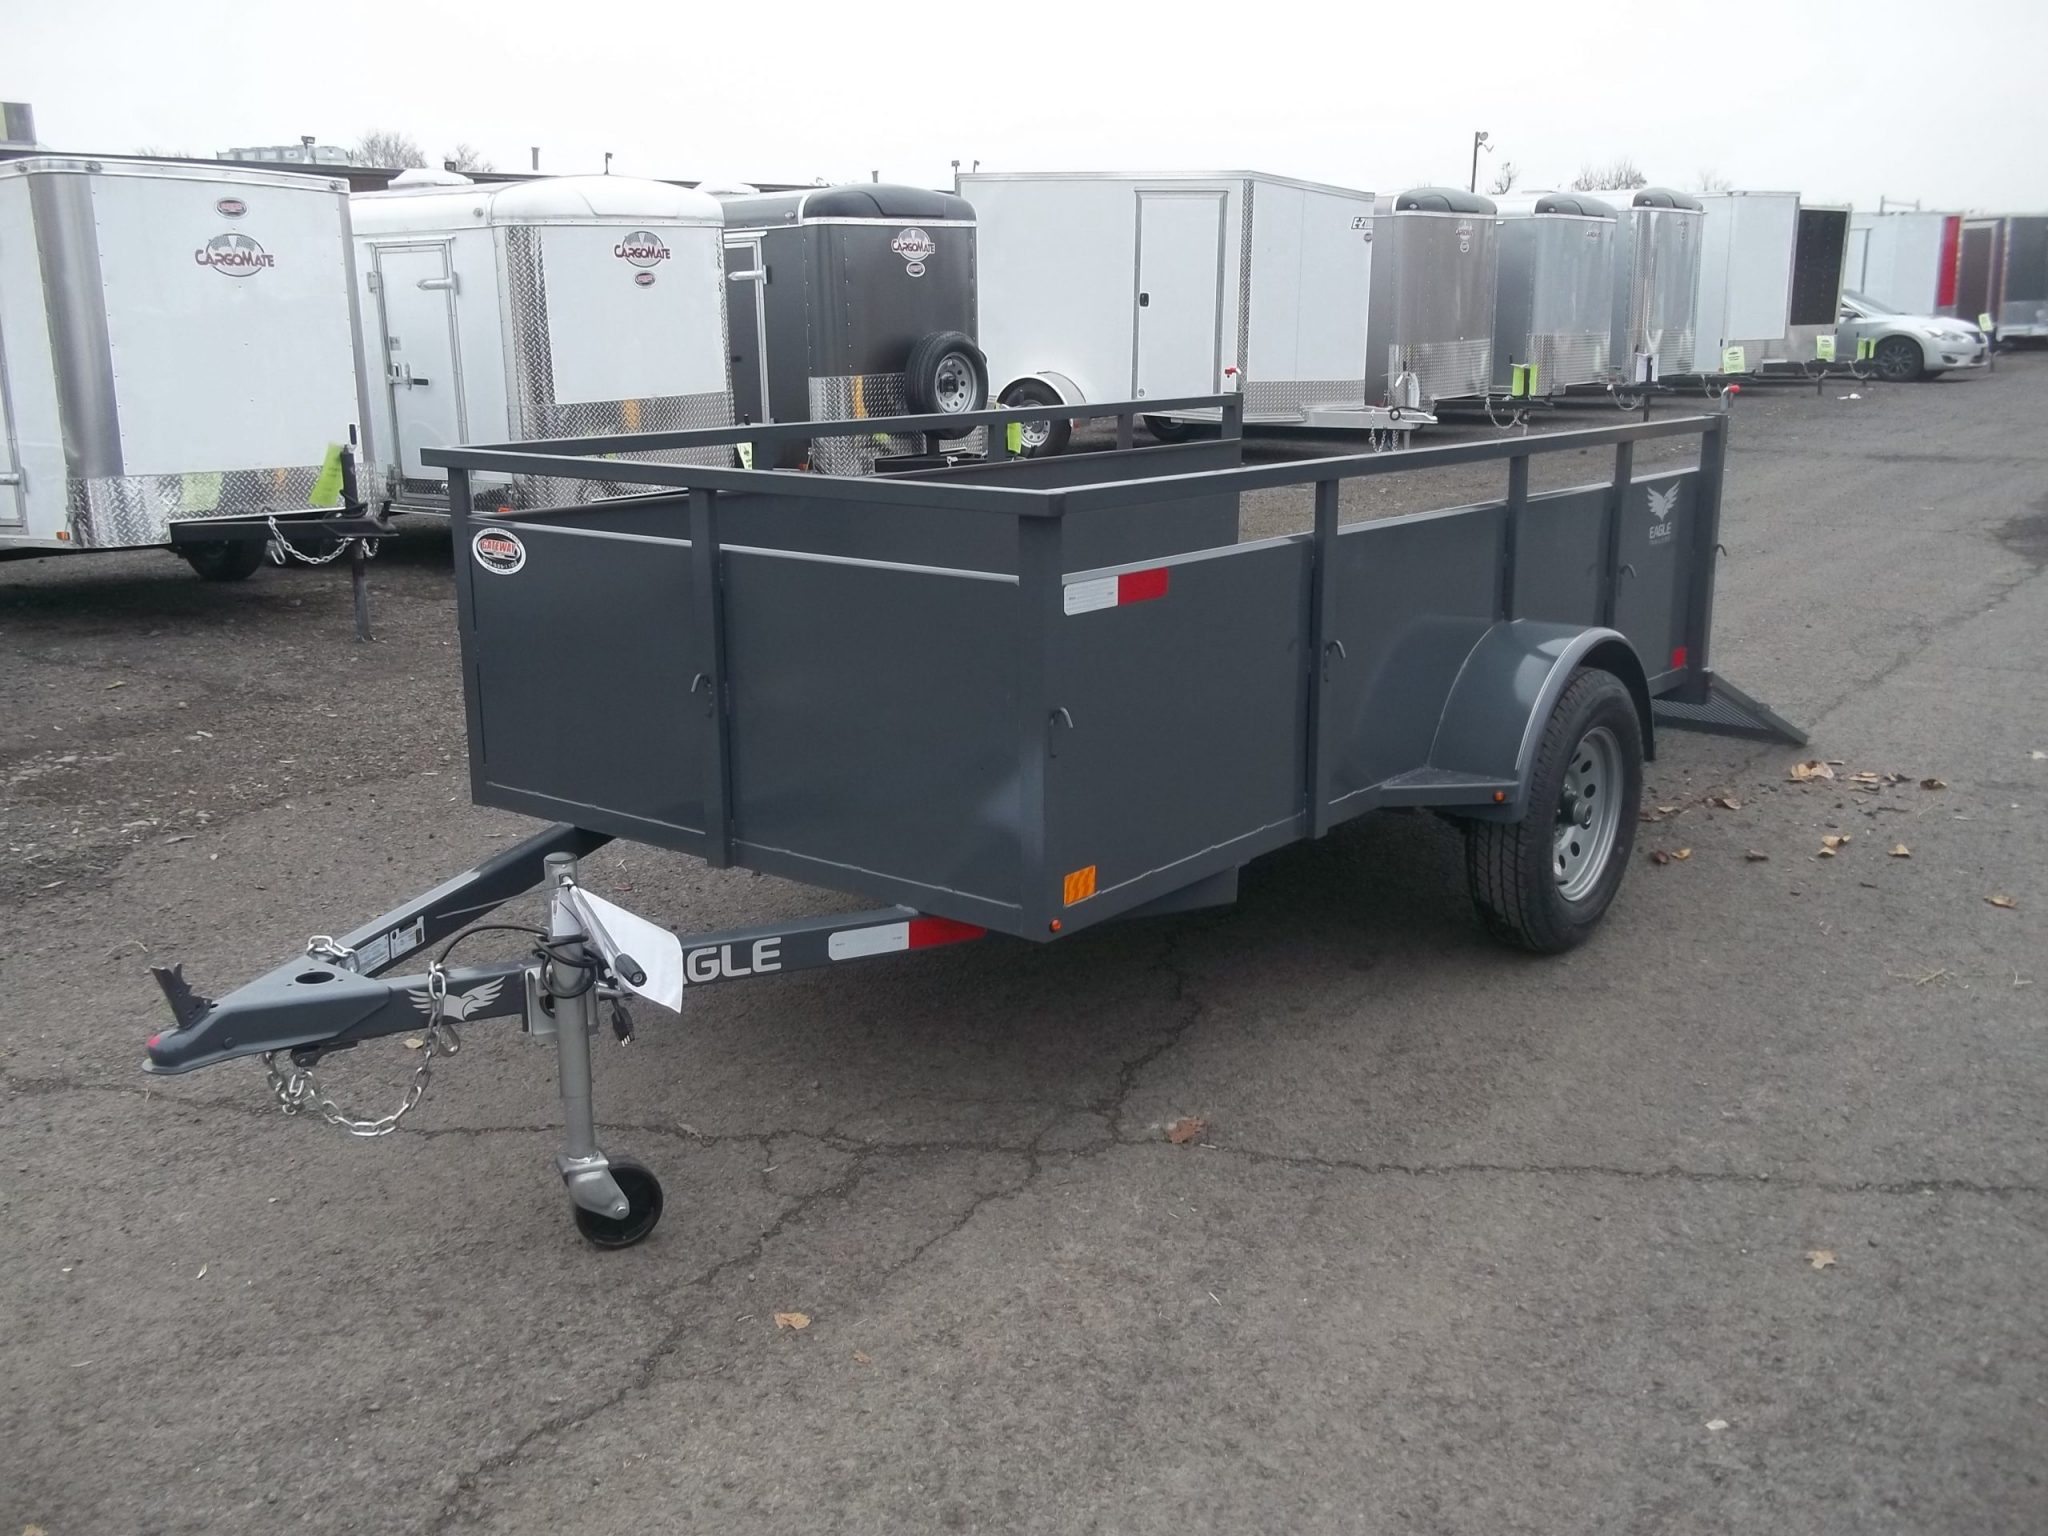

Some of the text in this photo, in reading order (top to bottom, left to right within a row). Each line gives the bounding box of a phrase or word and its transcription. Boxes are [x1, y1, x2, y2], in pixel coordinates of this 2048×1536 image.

[1649, 521, 1672, 539] EAGLE
[482, 539, 516, 555] GATEWAY
[683, 937, 782, 985] GLE
